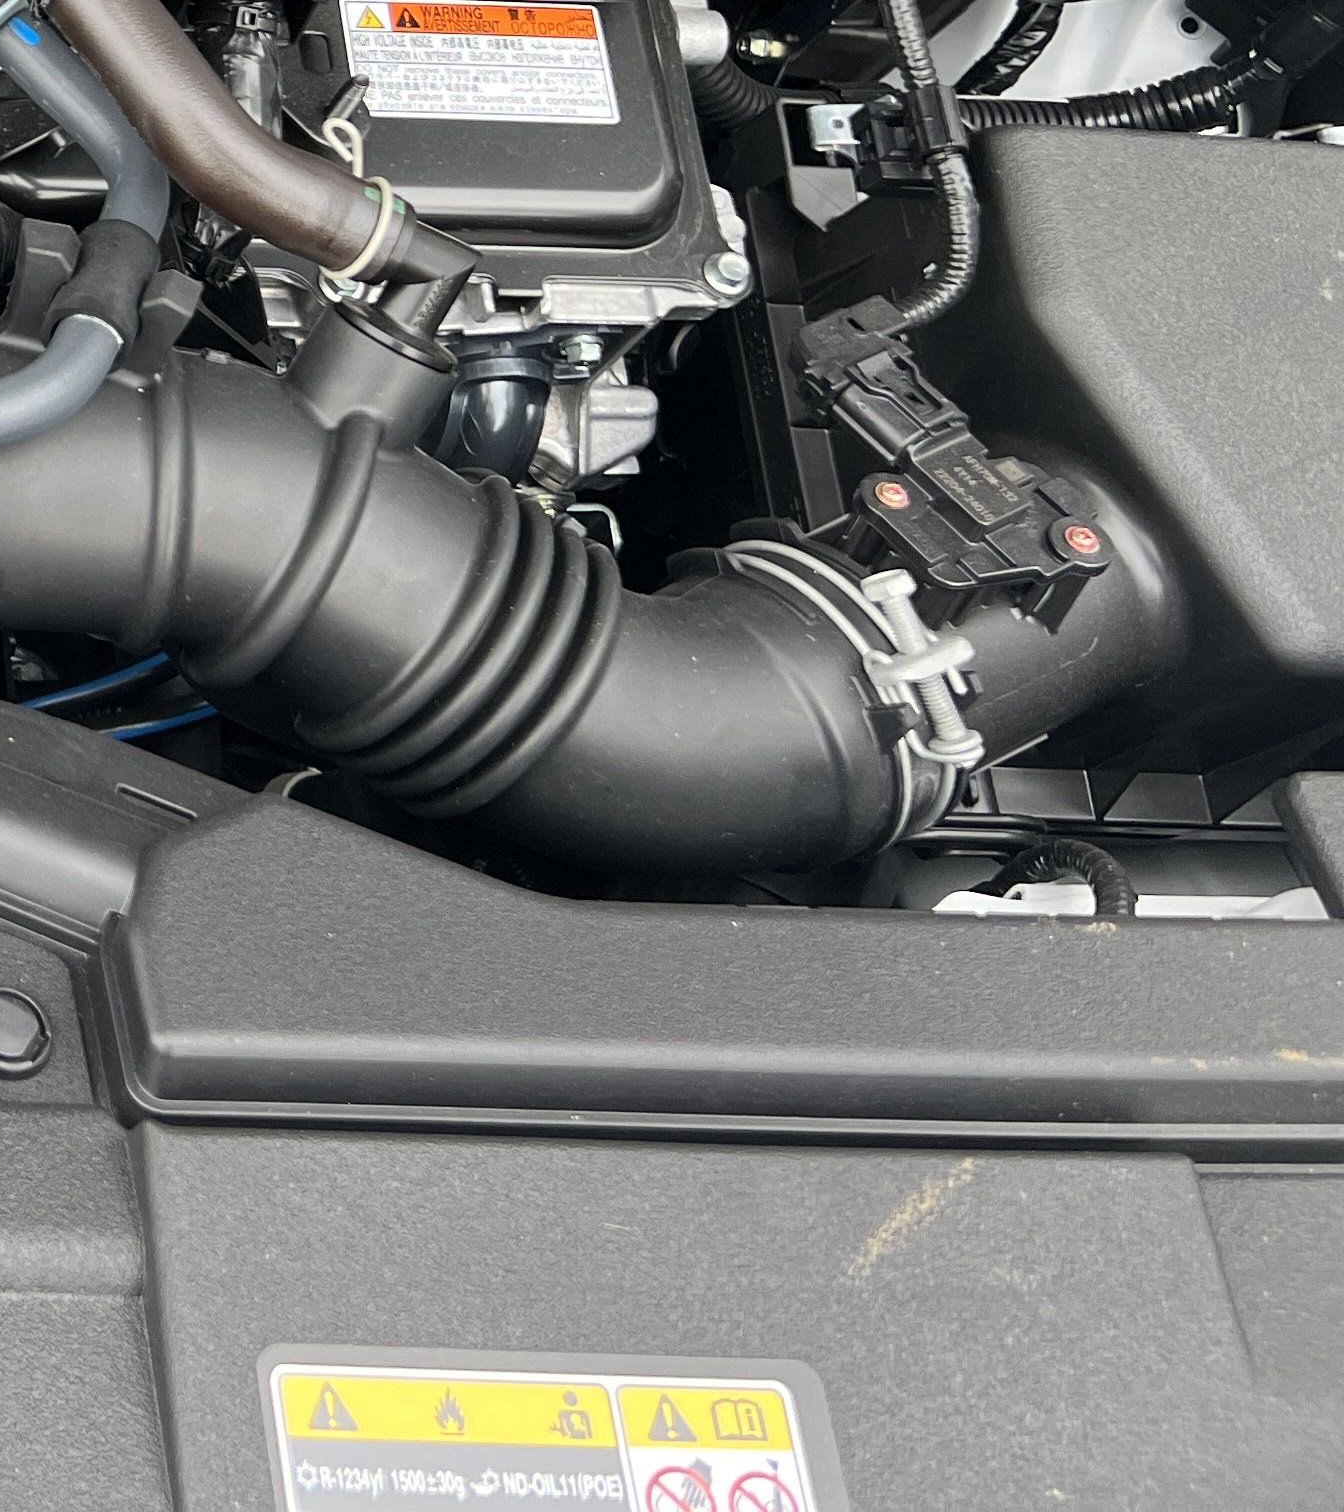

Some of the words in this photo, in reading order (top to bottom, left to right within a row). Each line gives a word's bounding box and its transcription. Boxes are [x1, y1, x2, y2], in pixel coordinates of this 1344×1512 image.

[420, 6, 483, 20] WARNING
[423, 18, 500, 33] AVERTISSEMENT
[378, 64, 400, 73] NOT
